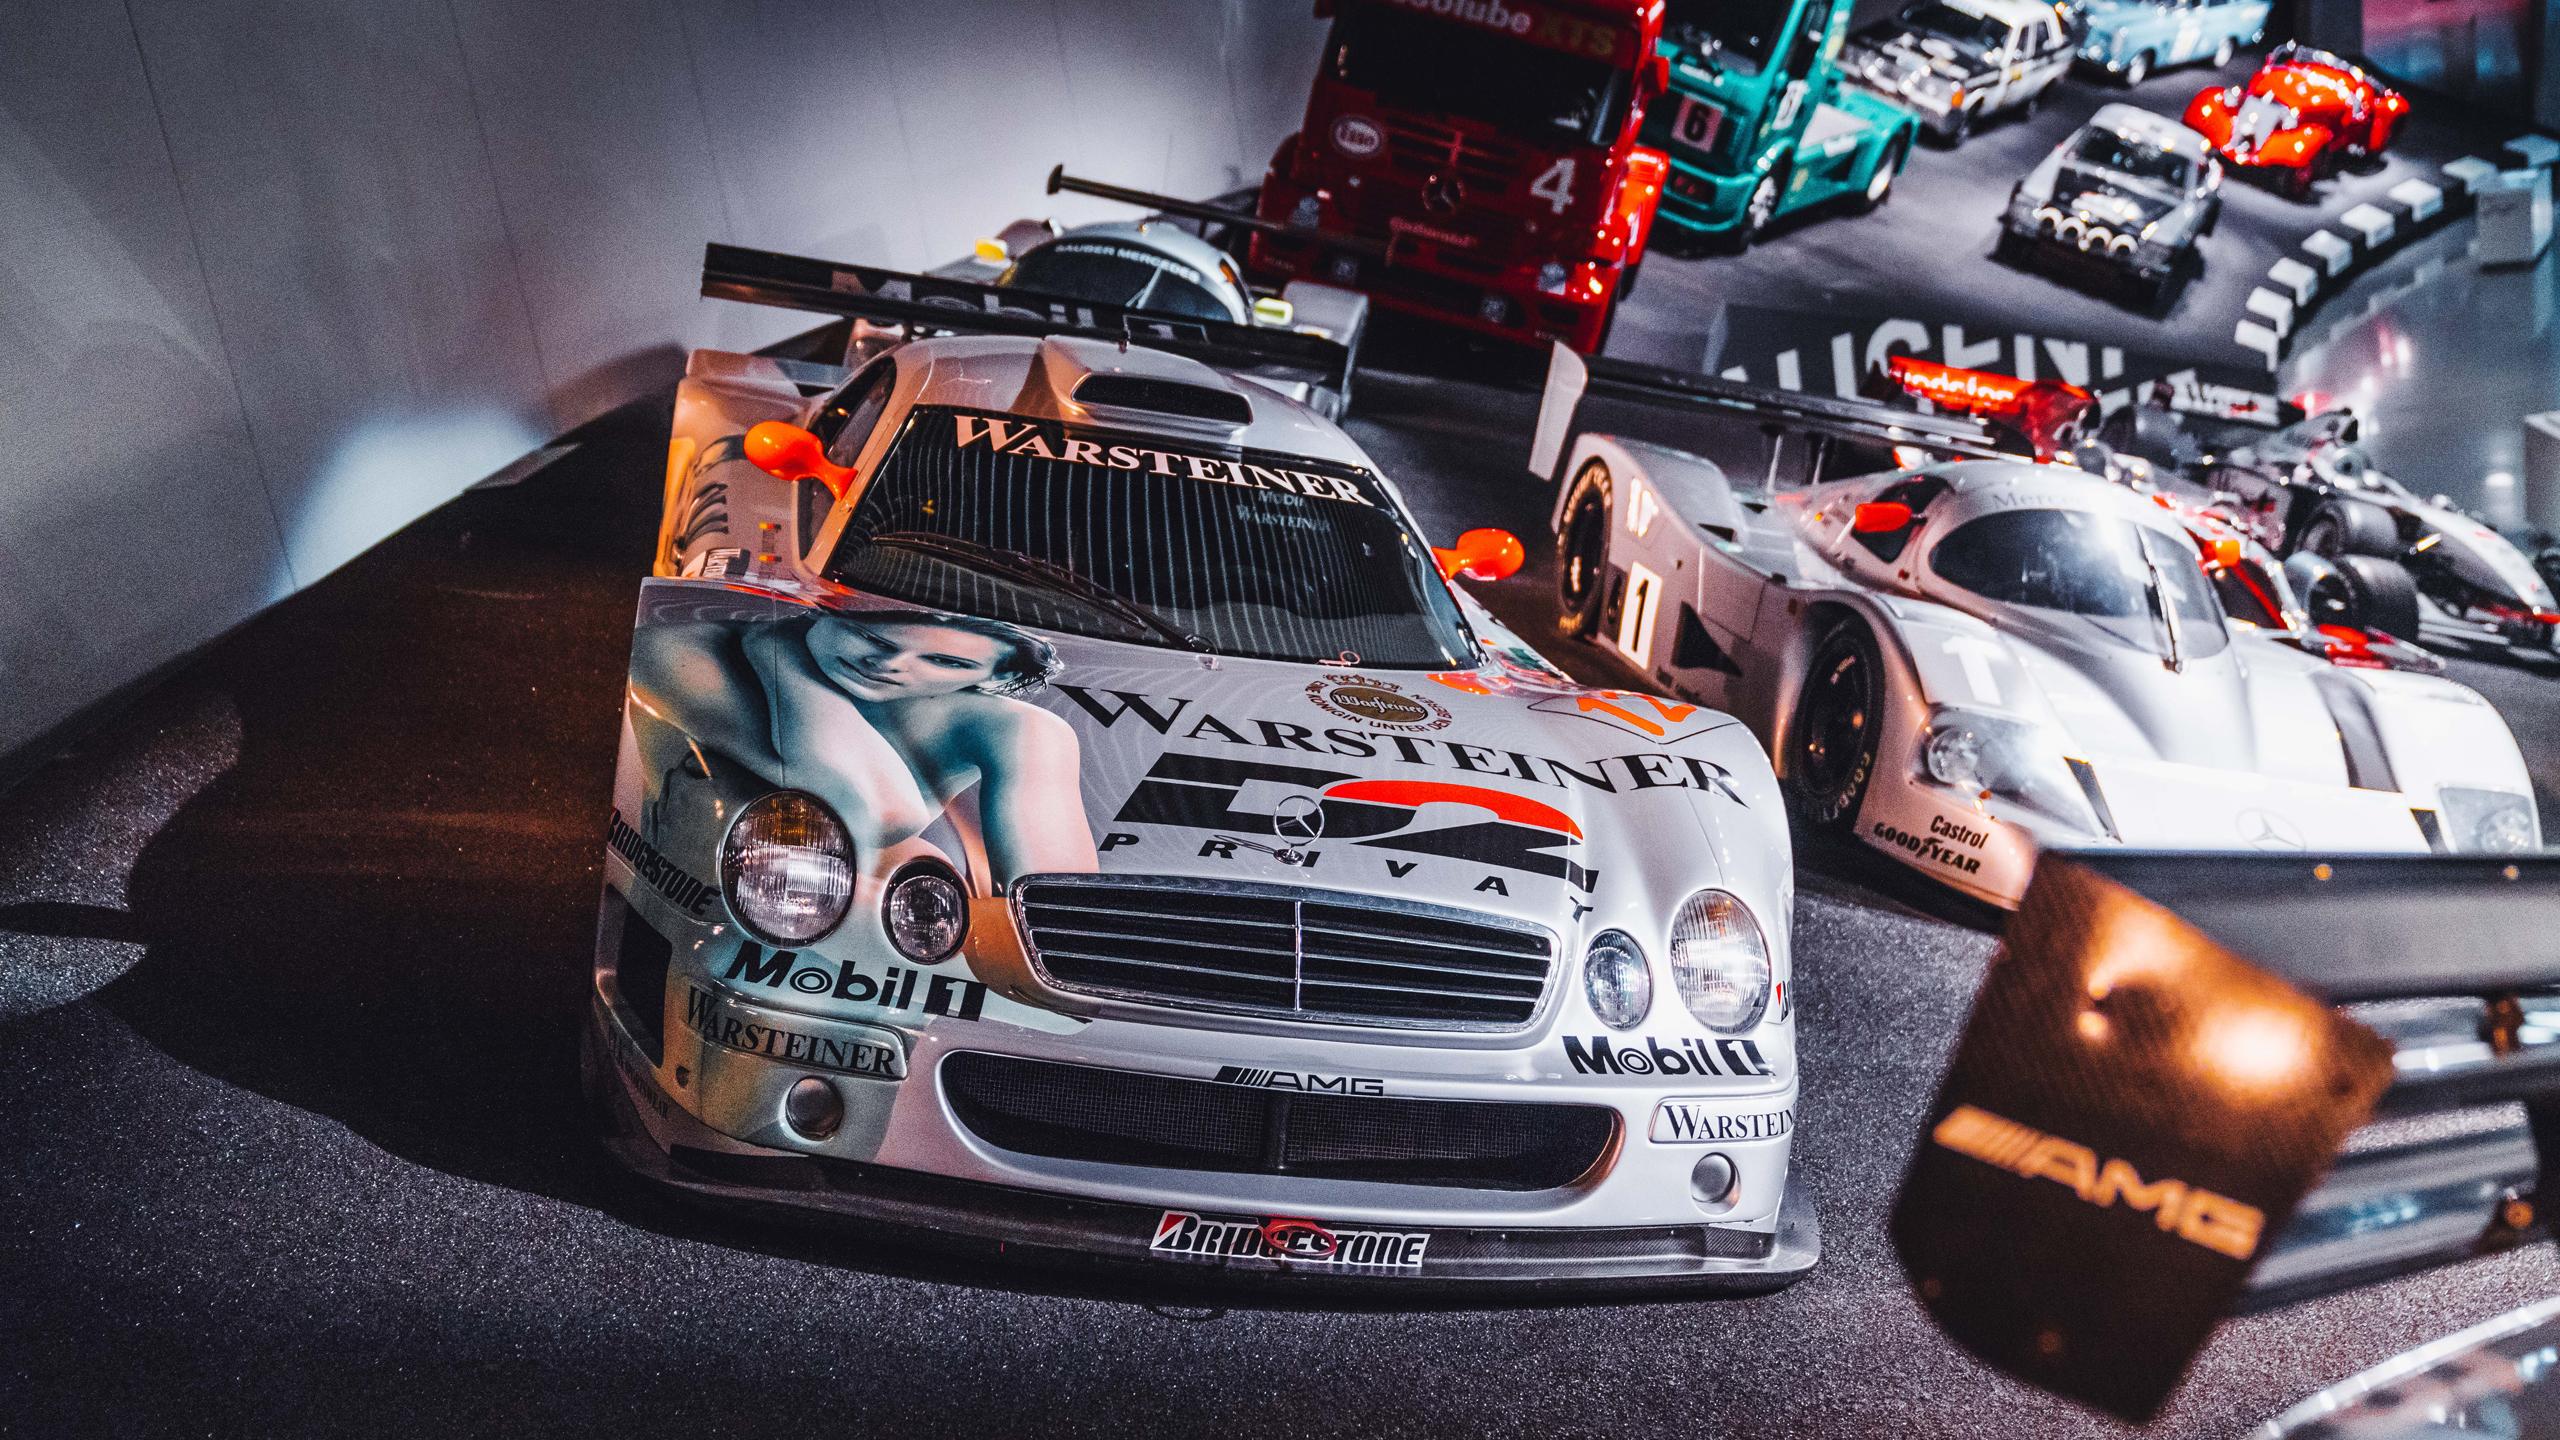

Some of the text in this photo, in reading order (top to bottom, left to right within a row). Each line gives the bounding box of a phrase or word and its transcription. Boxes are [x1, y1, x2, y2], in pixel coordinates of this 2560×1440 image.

[1685, 103, 1711, 141] 6
[1530, 158, 1576, 214] 4
[1054, 243, 1201, 285] SAUBER MERCEDES
[954, 414, 1375, 507] WARSTEINER
[1633, 578, 1650, 653] 1
[1050, 683, 1750, 809] WARSTEINER
[1113, 752, 1600, 893] D2
[1873, 821, 1981, 875] GOODYEAR
[1930, 814, 1989, 849] Castrol
[607, 807, 722, 916] BRIDGESTONE
[1099, 832, 1594, 923] PRIVAT
[724, 941, 918, 1011] Mobil
[688, 985, 896, 1075] WARSTEINER
[1562, 1035, 1723, 1076] Mobil
[1264, 1071, 1384, 1097] AMG
[2010, 1134, 2266, 1261] AMG
